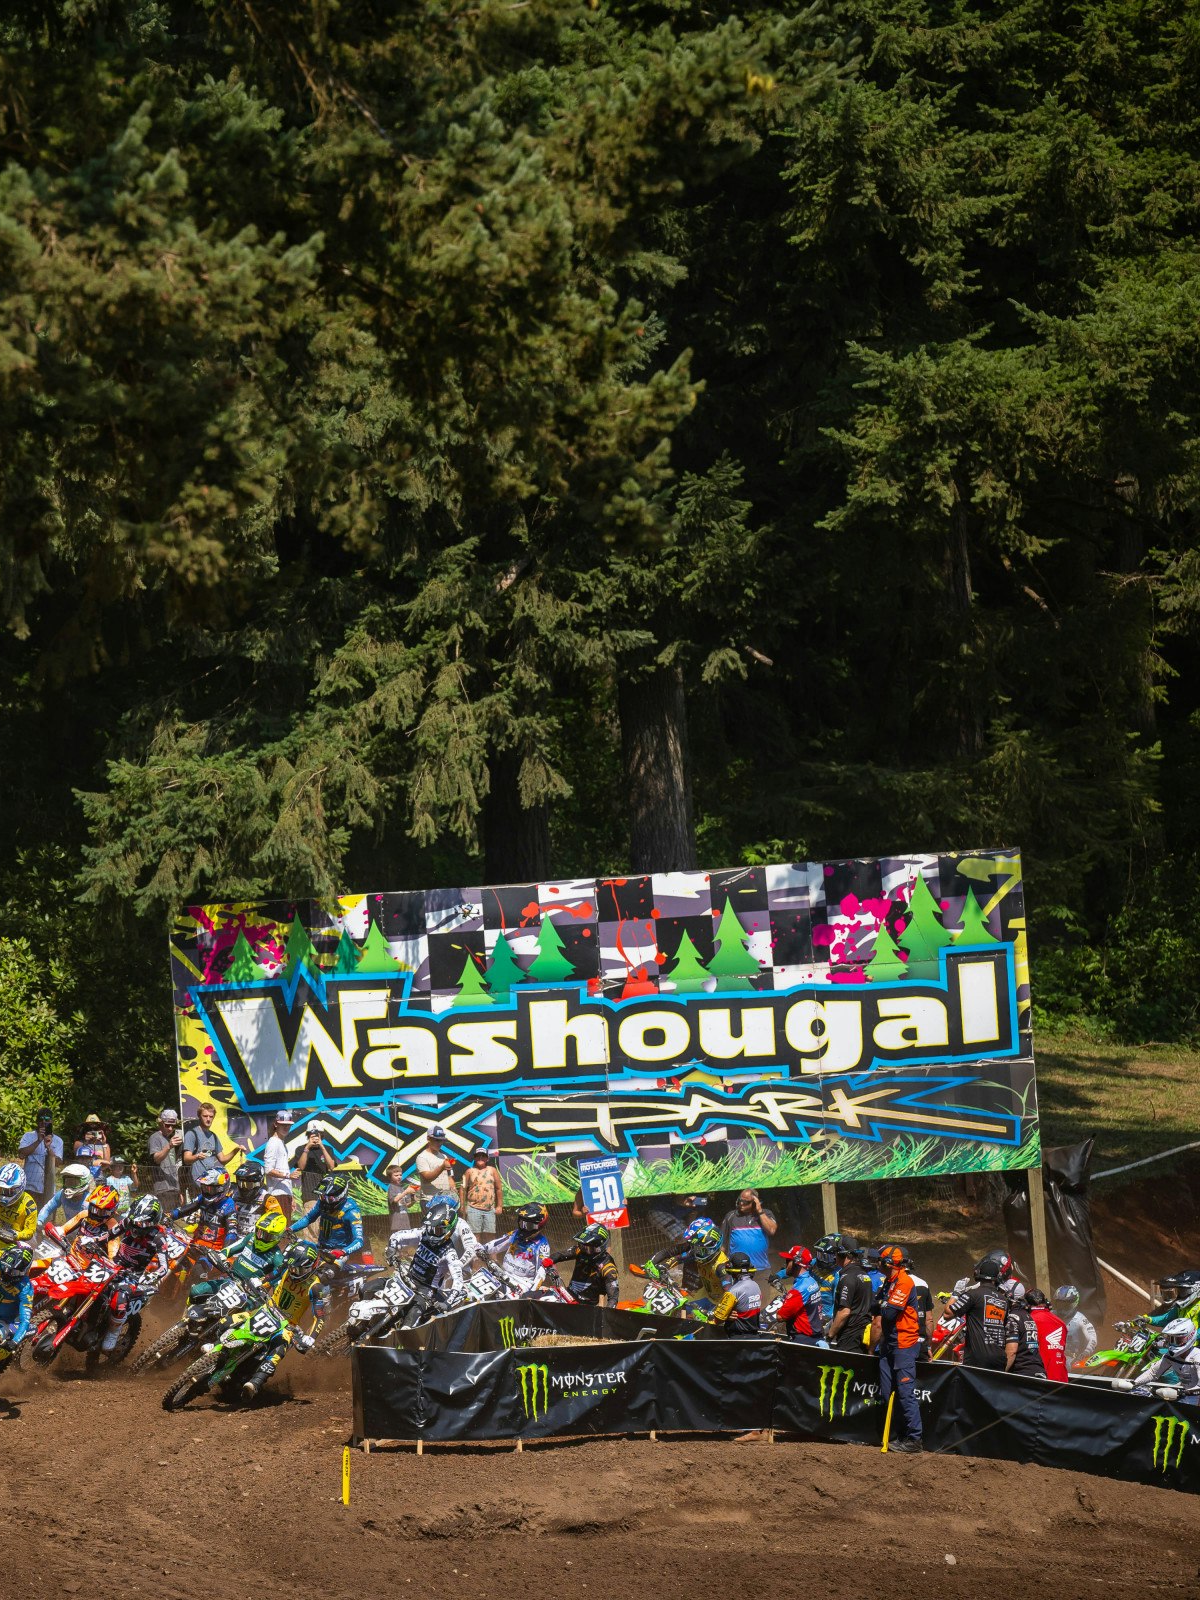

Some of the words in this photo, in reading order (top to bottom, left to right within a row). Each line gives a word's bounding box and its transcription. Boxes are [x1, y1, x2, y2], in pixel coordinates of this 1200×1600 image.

[215, 961, 999, 1094] Washougal
[513, 1088, 1007, 1147] PARK
[581, 1160, 618, 1172] MOTOCROSS
[590, 1176, 620, 1212] 30
[47, 1260, 74, 1284] 39
[383, 1282, 409, 1306] 35
[471, 1278, 497, 1297] 66
[652, 1294, 675, 1315] 29
[252, 1312, 278, 1335] 47
[552, 1371, 627, 1388] MONSTER
[563, 1388, 617, 1398] ENERGY
[853, 1381, 932, 1402] MOER
